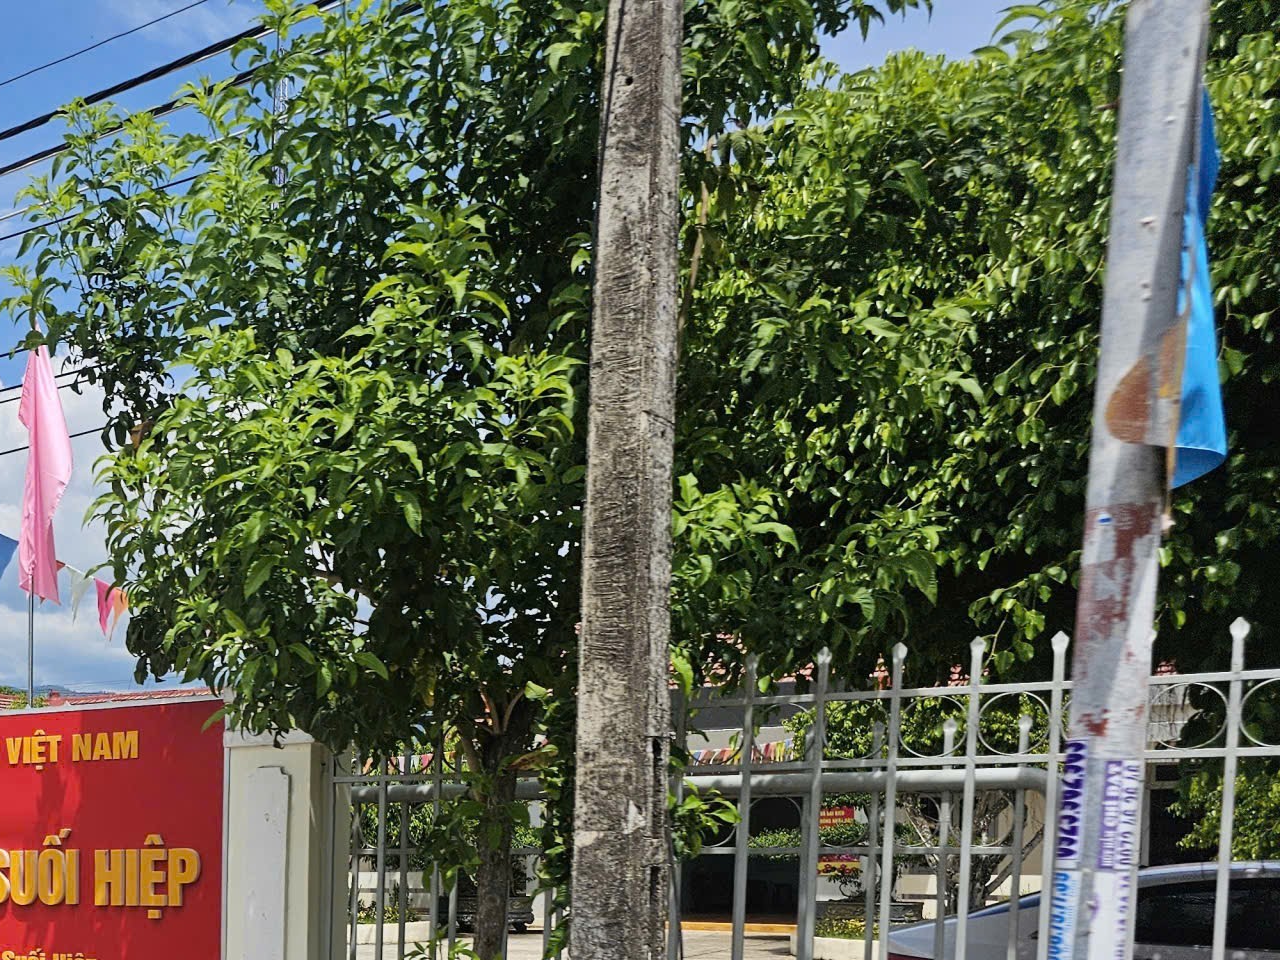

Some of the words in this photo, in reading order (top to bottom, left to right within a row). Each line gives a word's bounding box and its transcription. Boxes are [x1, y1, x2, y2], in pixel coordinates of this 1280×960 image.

[6, 729, 62, 770] VIỆT
[72, 730, 139, 763] NAM
[93, 834, 202, 920] HIỆP
